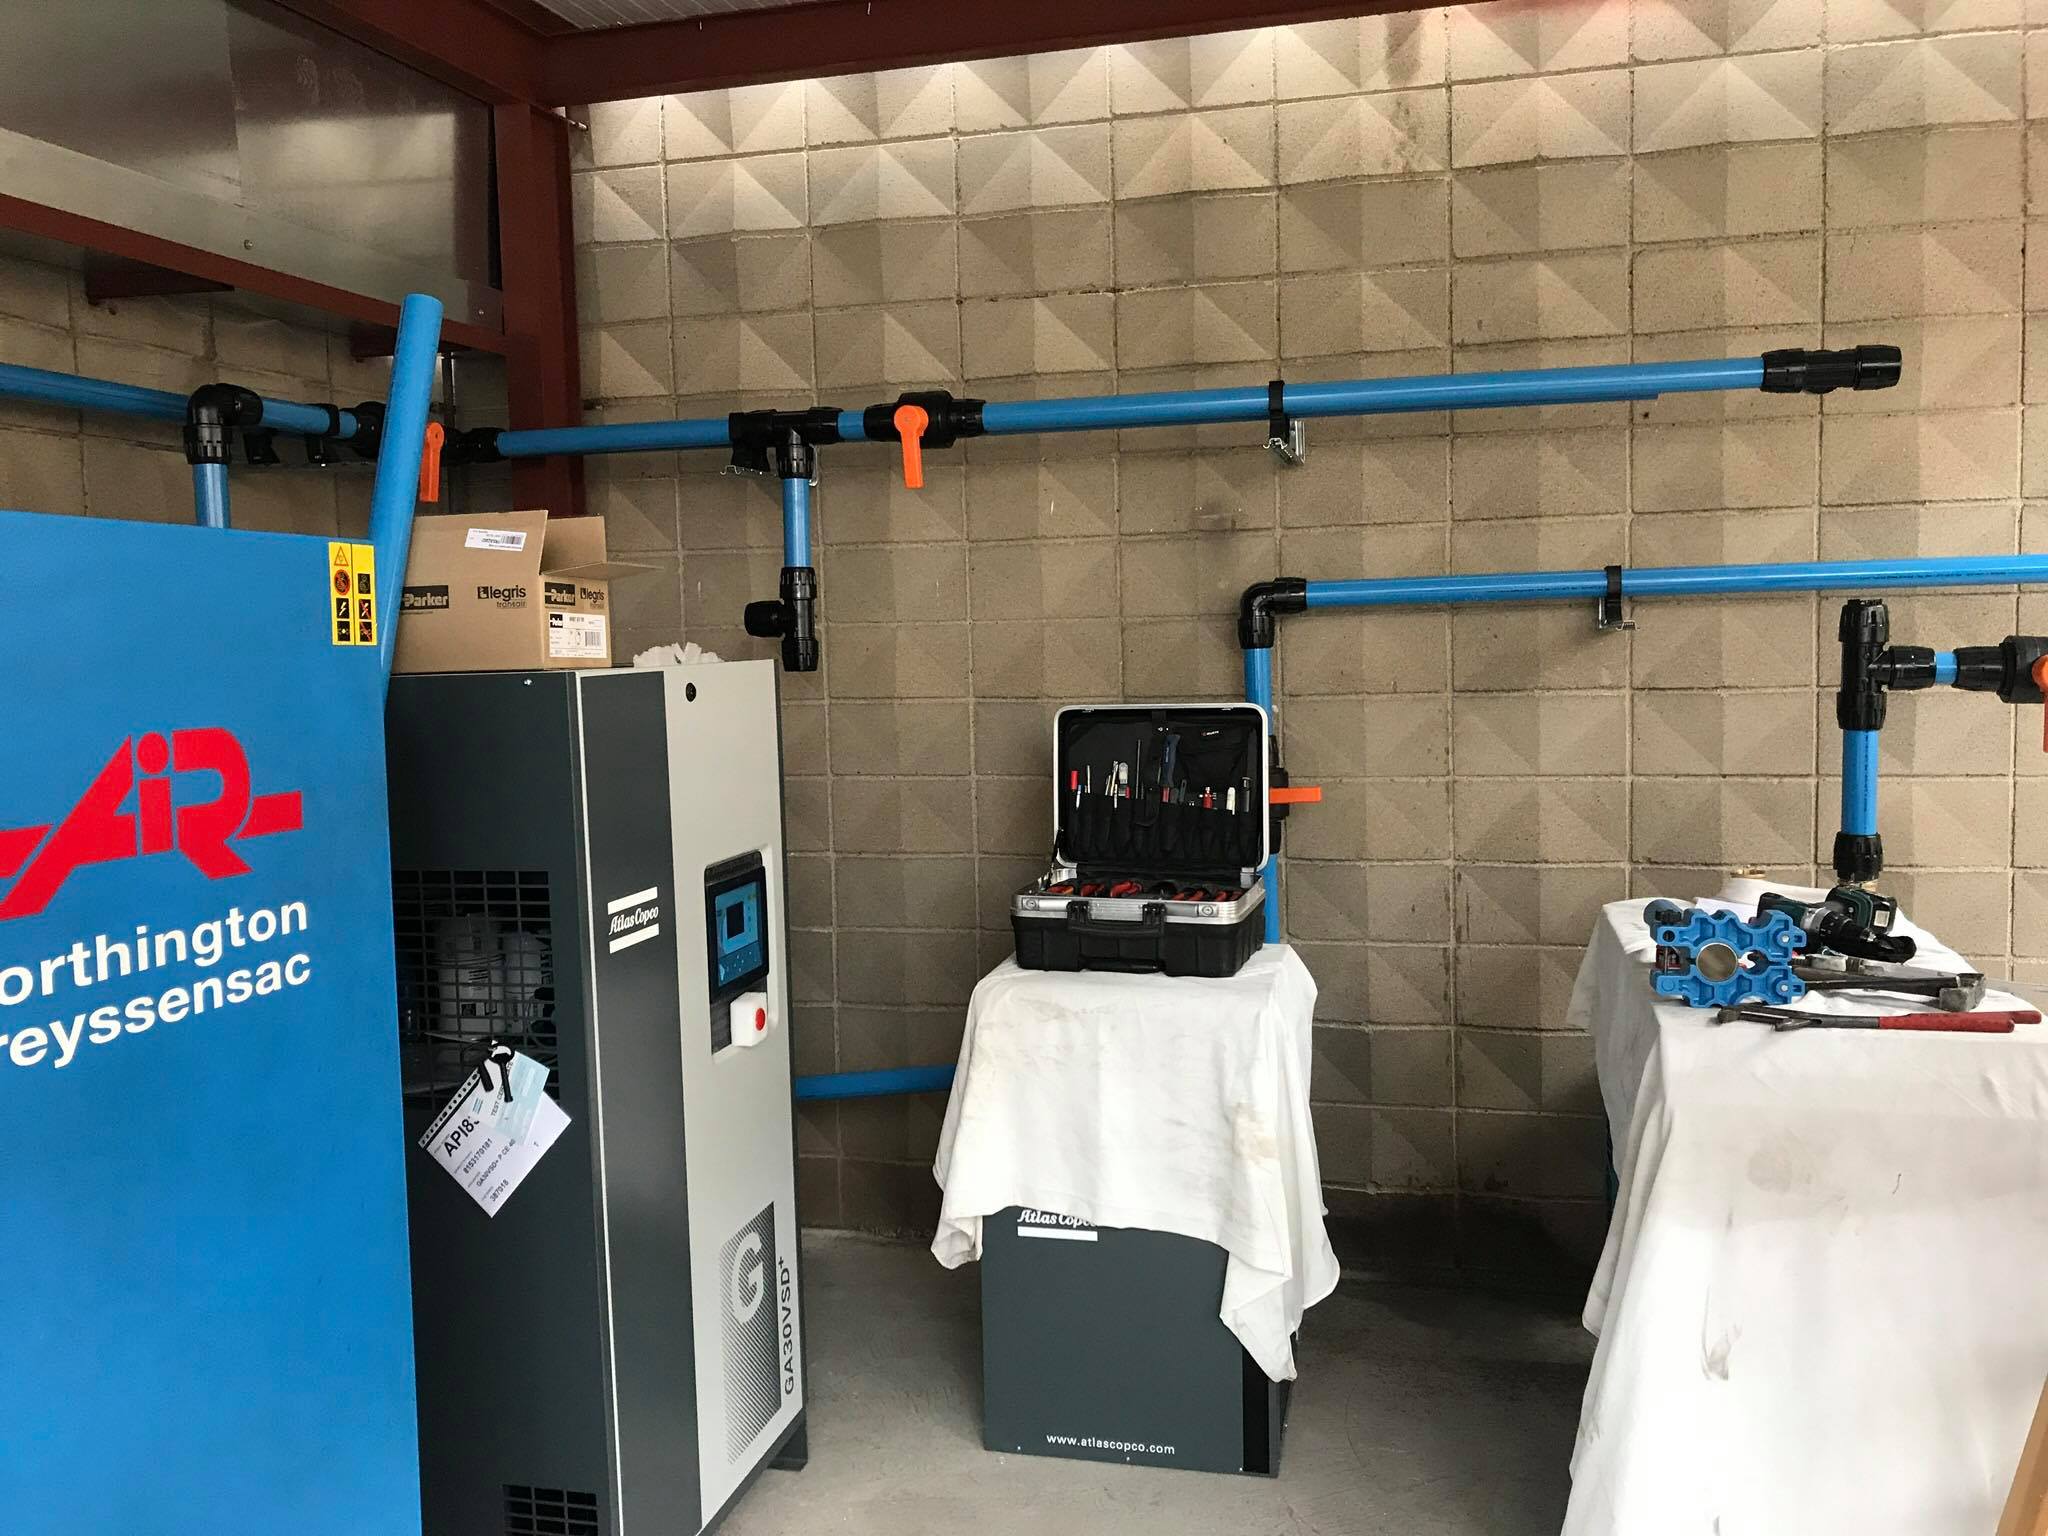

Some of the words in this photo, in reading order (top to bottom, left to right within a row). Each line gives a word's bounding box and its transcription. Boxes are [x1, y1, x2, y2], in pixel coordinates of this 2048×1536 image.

[402, 591, 449, 608] Parker
[490, 585, 526, 600] legris
[551, 588, 575, 603] Parker
[587, 588, 605, 603] legris
[608, 914, 634, 935] Atlas
[634, 906, 659, 925] Copco
[0, 900, 308, 1006] orthington
[1017, 1209, 1058, 1225] Atlas
[778, 1256, 795, 1395] GA30VSD+
[1046, 1434, 1175, 1455] www.atlascopco.com
